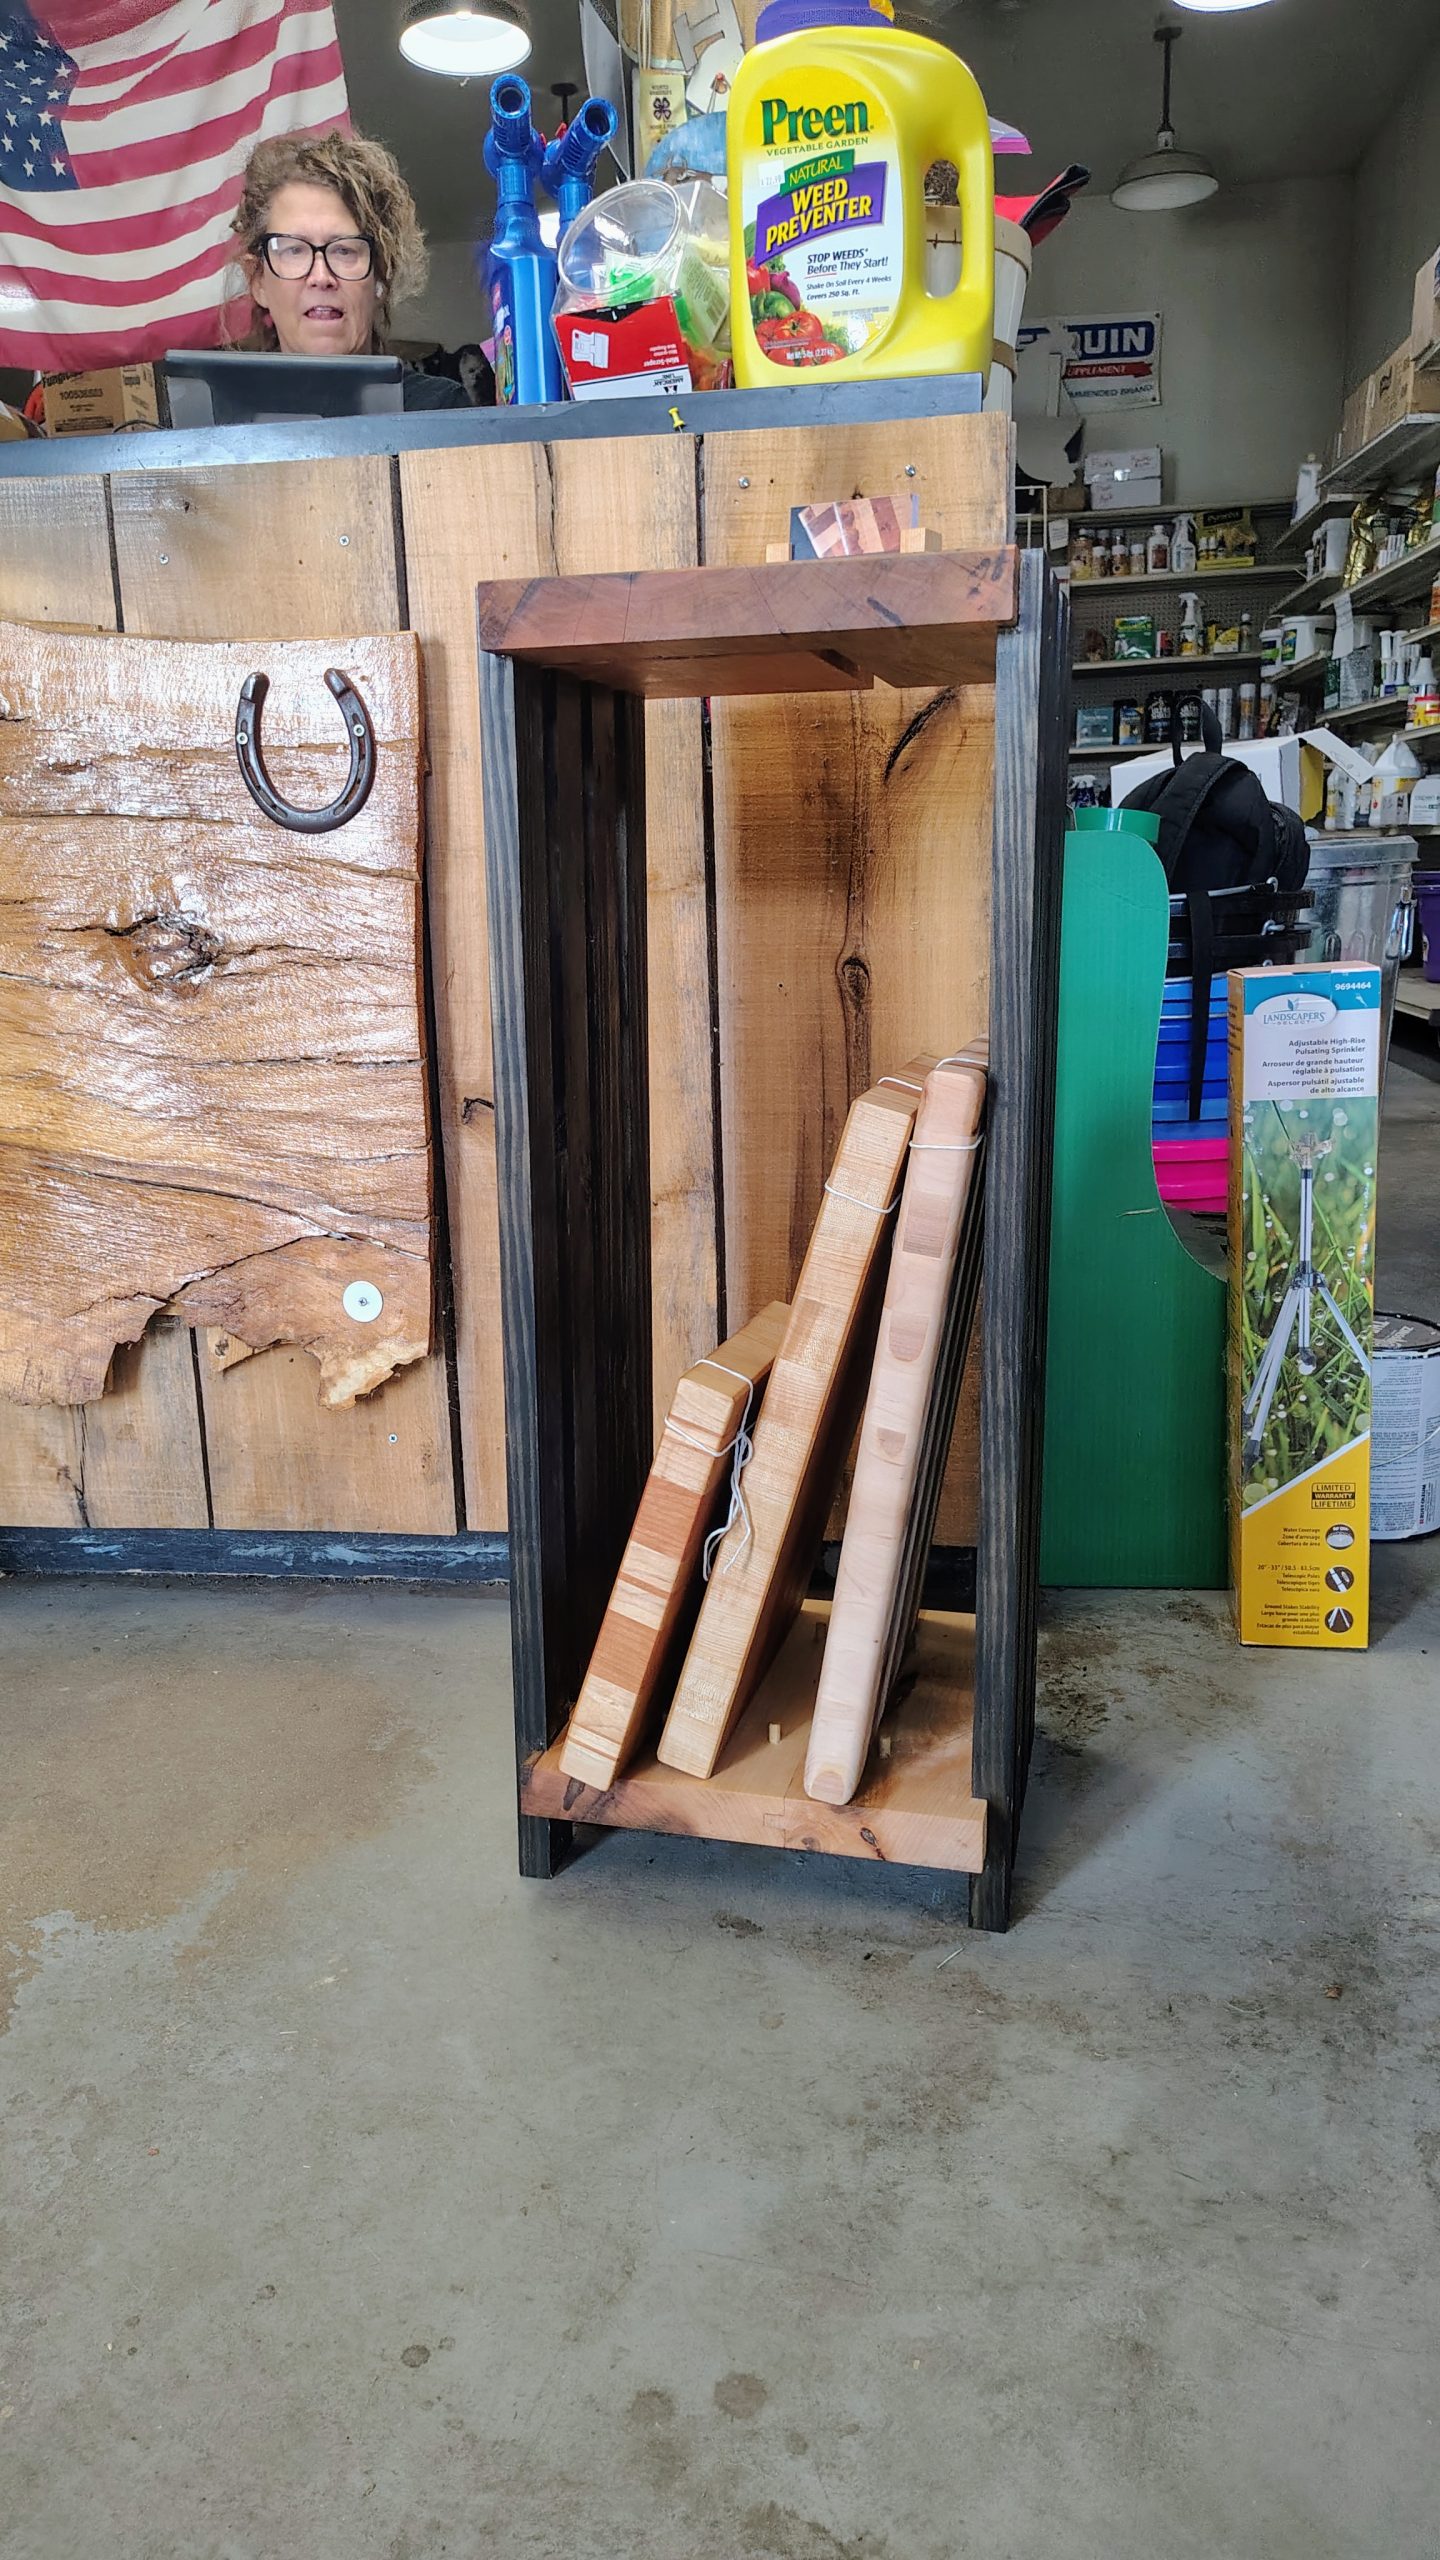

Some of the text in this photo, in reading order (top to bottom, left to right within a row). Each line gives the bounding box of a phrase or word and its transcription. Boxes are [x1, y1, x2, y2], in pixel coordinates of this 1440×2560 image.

[760, 98, 870, 146] Preen
[766, 136, 869, 157] VEGETABLE GARDEN
[789, 155, 844, 187] NATURAL
[791, 177, 849, 216] WEED
[765, 194, 873, 253] PREVENTER
[807, 252, 831, 265] STOP
[807, 255, 889, 275] Before They Start!
[806, 283, 824, 291] Shake
[825, 281, 835, 289] On
[847, 278, 865, 287] Every
[806, 293, 827, 301] Covers
[1120, 384, 1153, 396] BRAND
[1334, 981, 1372, 991] 9694464
[1263, 1011, 1325, 1025] LANDSCAPERS
[1288, 1037, 1366, 1048] Adjustable High-Rise
[1295, 1046, 1365, 1055] Pulsating Sprinkler
[1262, 1060, 1294, 1068] Arroseur
[1306, 1058, 1333, 1067] grande
[1334, 1057, 1363, 1065] hauteur
[1330, 1065, 1365, 1074] pulsation
[1267, 1080, 1300, 1088] Aspersor
[1330, 1077, 1365, 1086] ajustable
[1320, 1086, 1335, 1094] alto
